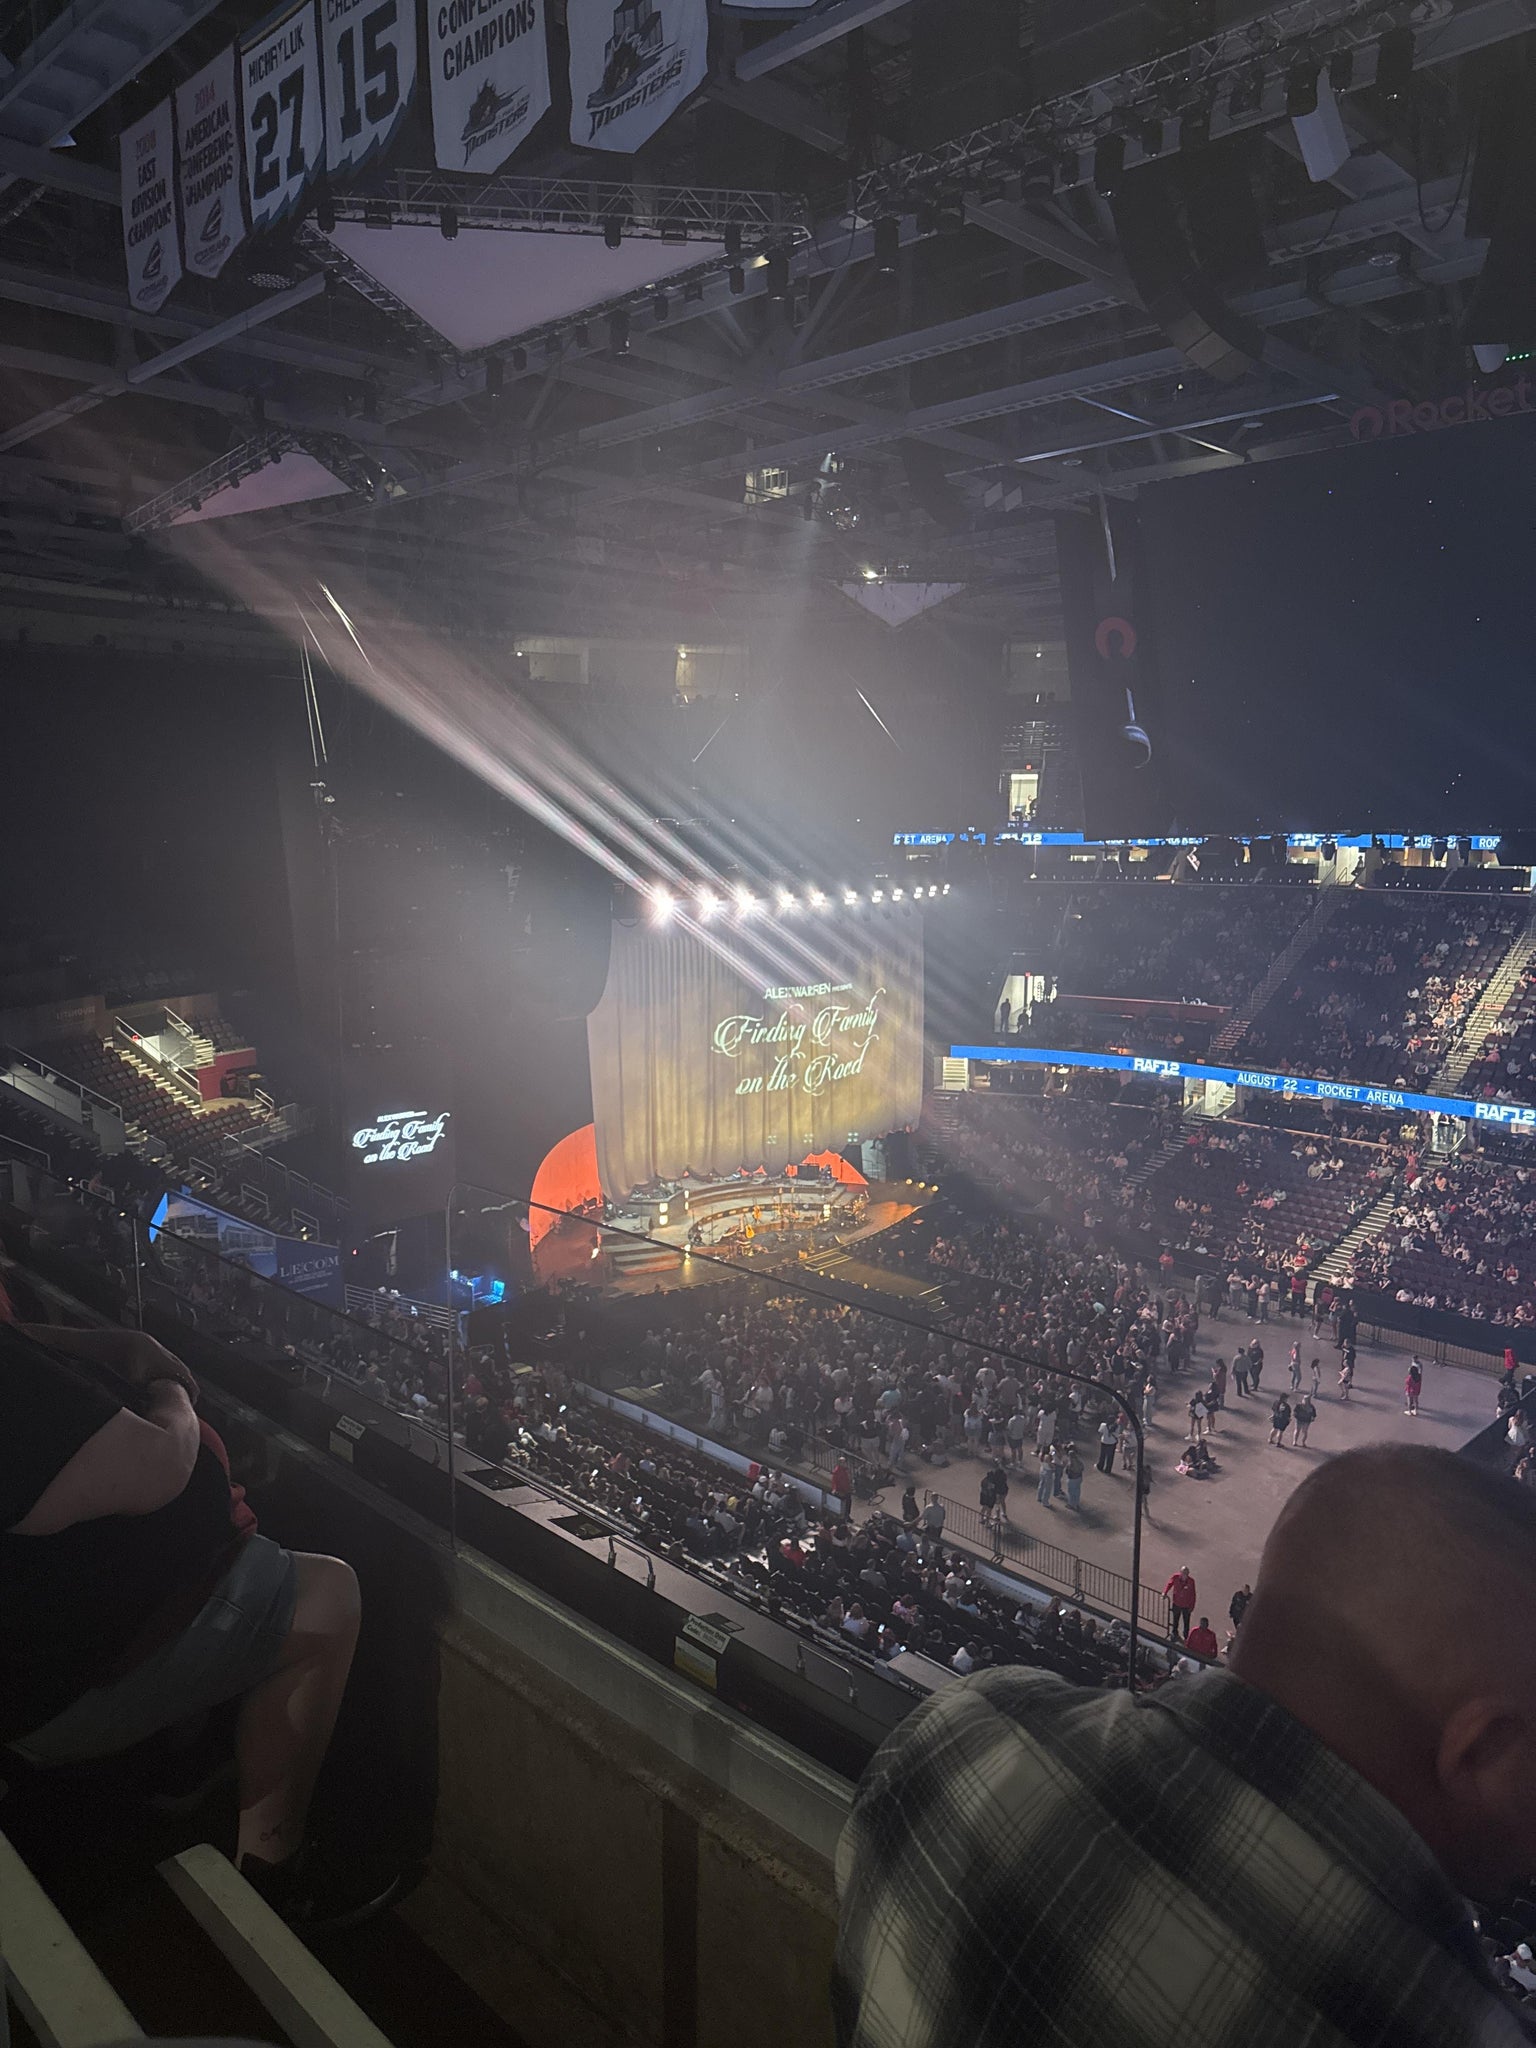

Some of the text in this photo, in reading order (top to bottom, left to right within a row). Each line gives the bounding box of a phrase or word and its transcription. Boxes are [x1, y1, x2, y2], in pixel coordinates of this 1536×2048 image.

[443, 0, 536, 81] CHAMPIONS
[337, 0, 400, 144] 15
[185, 100, 231, 153] AMERICAN
[251, 64, 305, 199] 27
[137, 157, 157, 188] EAST
[1389, 373, 1532, 434] Rocket
[711, 987, 886, 1059] Finding Family
[735, 1034, 879, 1096] on the Road
[1134, 1057, 1180, 1076] RAF12
[1237, 1072, 1278, 1089] AUGUST
[1283, 1078, 1298, 1090] 22
[1318, 1083, 1360, 1100] ROCKET
[1366, 1091, 1404, 1105] ARENA
[1475, 1103, 1536, 1126] RAF12
[352, 1121, 400, 1148] Finding
[402, 1112, 450, 1140] Family
[363, 1133, 445, 1164] on the Road
[280, 1255, 340, 1278] LECOM
